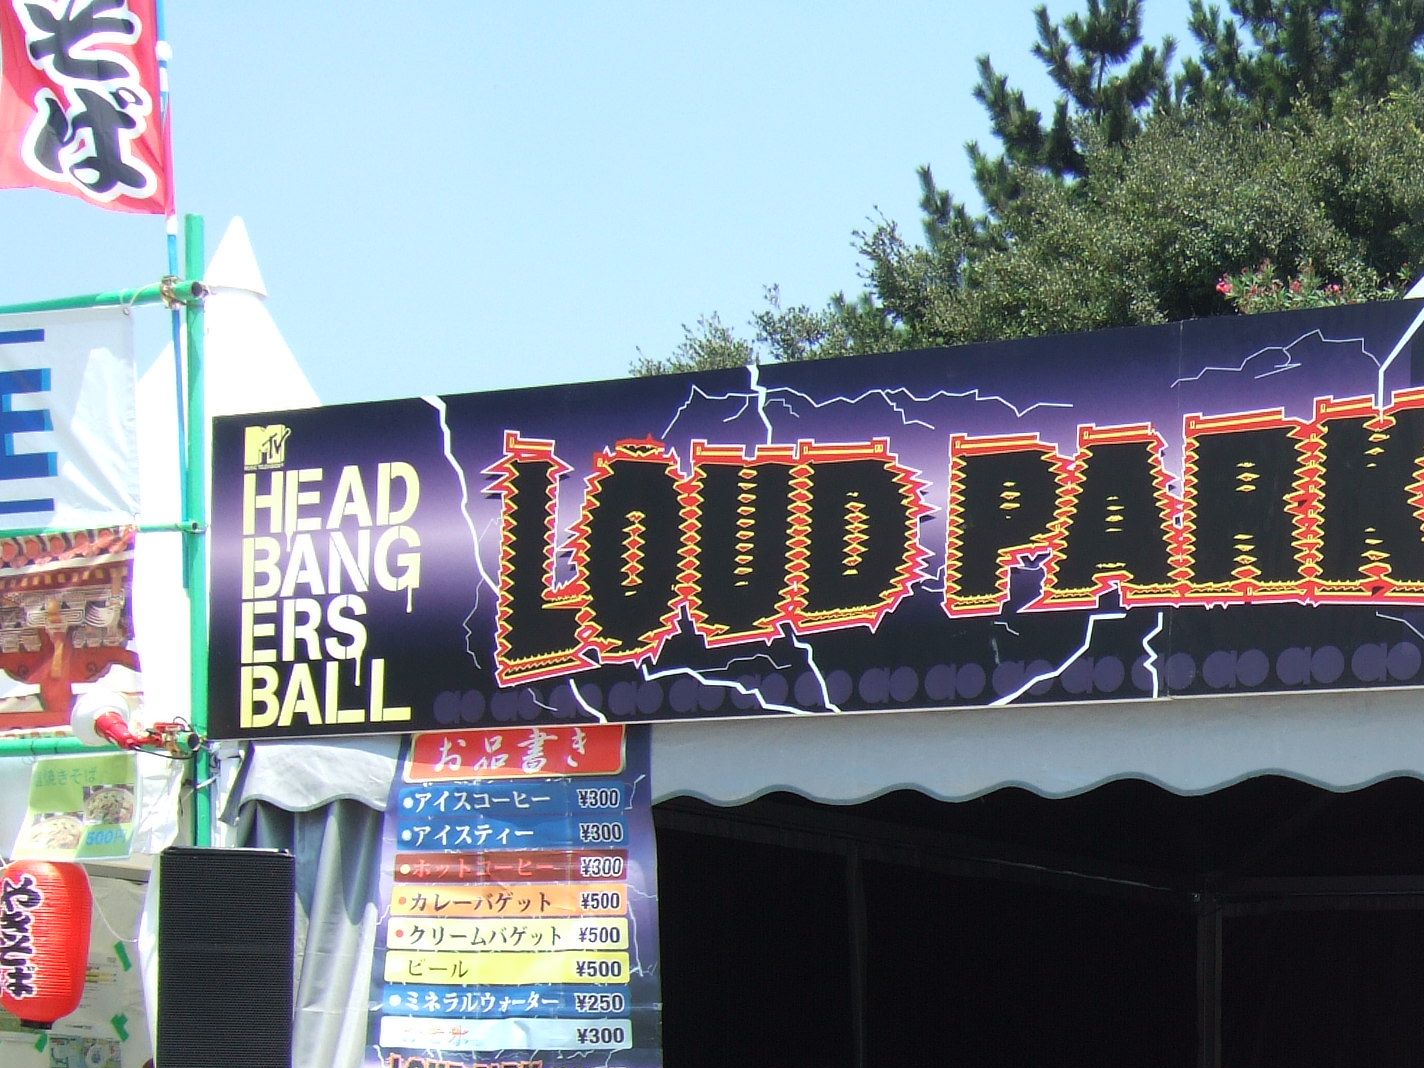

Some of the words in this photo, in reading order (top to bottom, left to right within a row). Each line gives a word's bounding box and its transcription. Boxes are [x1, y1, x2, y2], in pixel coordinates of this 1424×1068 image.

[244, 424, 292, 466] MTV
[242, 461, 421, 540] HEAD
[241, 525, 422, 606] BANG
[481, 430, 942, 688] LOUD
[240, 593, 368, 672] ERS
[239, 657, 412, 729] BALL
[434, 726, 589, 775] お品書き
[414, 790, 551, 814] アイスコーヒー
[578, 788, 620, 809] ¥300
[413, 824, 535, 846] アイスティー
[580, 822, 622, 842] ¥300
[412, 856, 555, 879] ホットコーヒー
[581, 857, 623, 877] ¥300
[410, 891, 551, 912] カレーバゲット
[581, 892, 620, 911] ¥500
[408, 923, 562, 948] クリームバゲット
[578, 925, 621, 945] ¥500
[408, 957, 469, 978] ビール
[576, 960, 622, 979] ¥500
[404, 990, 560, 1013] ミネラルウォーター
[574, 992, 625, 1013] ¥250
[576, 1026, 626, 1046] ¥300
